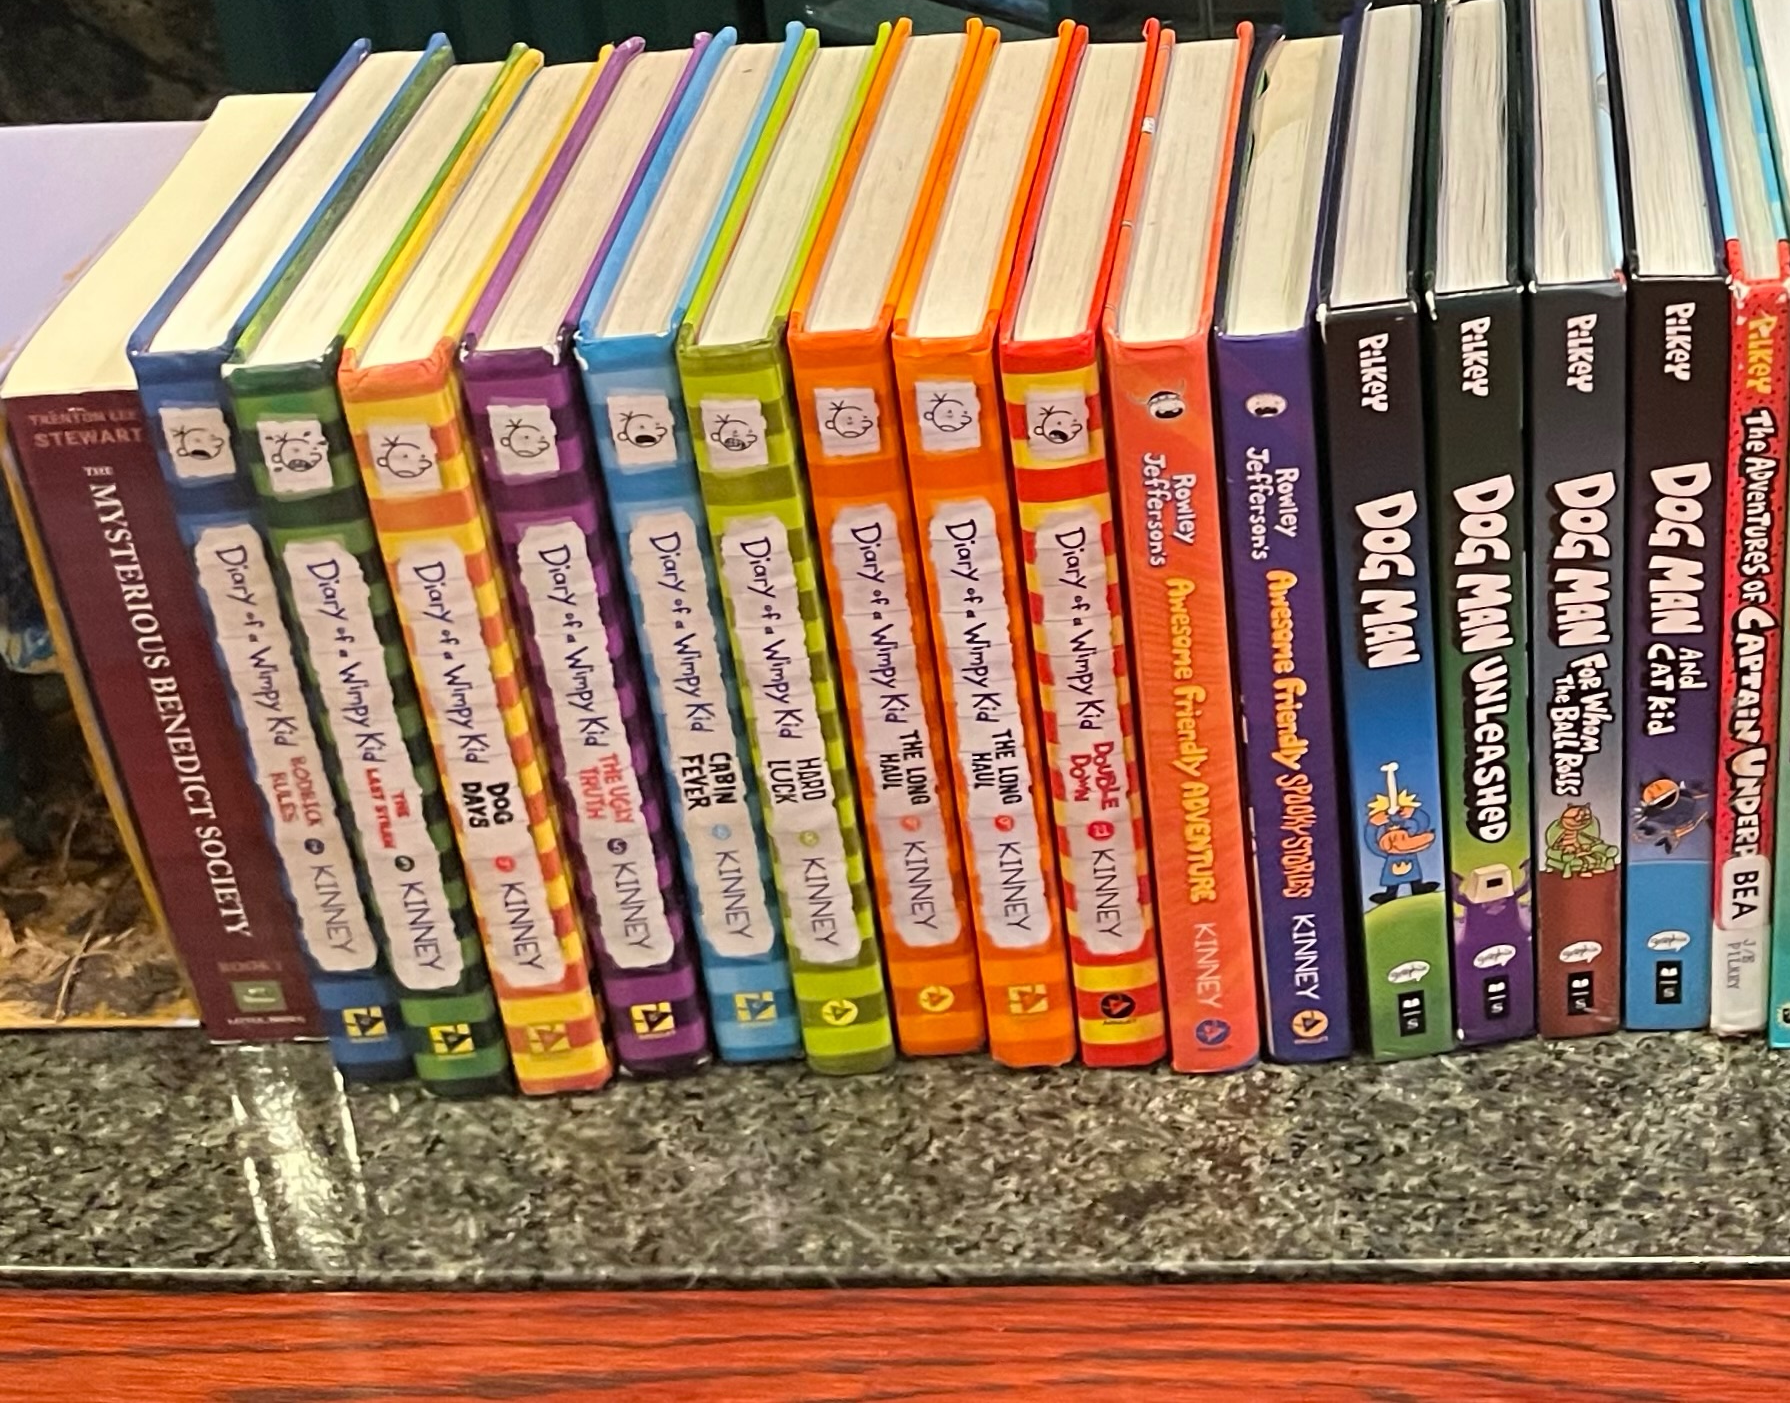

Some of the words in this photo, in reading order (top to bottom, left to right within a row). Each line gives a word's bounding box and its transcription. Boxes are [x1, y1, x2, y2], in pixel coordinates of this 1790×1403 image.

[33, 427, 143, 447] STEWART
[1143, 452, 1172, 567] Jefferson's
[1172, 473, 1197, 546] Rowley
[1246, 447, 1274, 560] Jefferson's
[1274, 467, 1300, 538] Rowley
[1453, 474, 1515, 566] DOG
[1554, 471, 1616, 559] DOG
[1648, 462, 1712, 547] DOG
[650, 531, 686, 593] Diary
[740, 537, 776, 599] Diary
[851, 522, 885, 584] Diary
[945, 519, 979, 582] Diary
[1355, 490, 1418, 581] DOG
[412, 561, 454, 625] Diary
[538, 544, 577, 606] Diary
[1554, 568, 1611, 647] MAN
[1649, 555, 1705, 634] MAN
[215, 545, 256, 606] Diary
[250, 646, 282, 713] Wimpy
[266, 716, 299, 746] Kid
[1165, 577, 1196, 680] Awesome
[1266, 569, 1297, 674] Awesome
[1360, 589, 1421, 669] MAN
[1456, 574, 1514, 653] MAN
[306, 559, 348, 621] Diary
[339, 661, 371, 728] Wimpy
[356, 732, 388, 763] Kid
[565, 646, 595, 713] Wimpy
[673, 633, 702, 698] Wimpy
[763, 639, 791, 704] Wimpy
[869, 623, 898, 689] Wimpy
[961, 622, 991, 688] Wimpy
[1647, 643, 1676, 691] CAT
[90, 482, 170, 670] MYSTERIOUS
[149, 678, 216, 820] BENEDICT
[195, 824, 254, 938] SOCIETY
[444, 664, 475, 730] Wimpy
[685, 702, 716, 733] Kid
[773, 709, 803, 739] Kid
[879, 693, 910, 724] Kid
[971, 692, 1002, 723] Kid
[1271, 677, 1309, 771] Friendly
[458, 732, 490, 764] Kid
[578, 716, 610, 748] Kid
[900, 729, 923, 760] THE
[1172, 685, 1208, 777] Friendly
[579, 766, 605, 820] TRUTH
[599, 752, 623, 784] THE
[679, 753, 712, 811] FEVER
[709, 751, 738, 805] CABIN
[767, 760, 798, 804] LUCK
[797, 756, 827, 801] HARD
[879, 753, 903, 790] HAUL
[906, 766, 931, 806] LONG
[972, 752, 995, 790] HAUL
[998, 765, 1023, 806] LONG
[461, 781, 491, 829] DAYS
[486, 782, 514, 826] DOG
[609, 787, 635, 824] UGLY
[1275, 773, 1317, 838] SPOOKY
[1180, 781, 1217, 903] ADVENTURE
[1280, 837, 1315, 899] STORIES
[311, 864, 355, 954] KINNEY
[612, 862, 654, 950] KINNEY
[715, 850, 753, 939] KINNEY
[802, 857, 839, 947] KINNEY
[903, 840, 938, 930] KINNEY
[997, 841, 1032, 932] KINNEY
[1091, 848, 1123, 938] KINNEY
[1732, 870, 1759, 920] BEA
[400, 881, 446, 972] KINNEY
[500, 881, 546, 972] KINNEY
